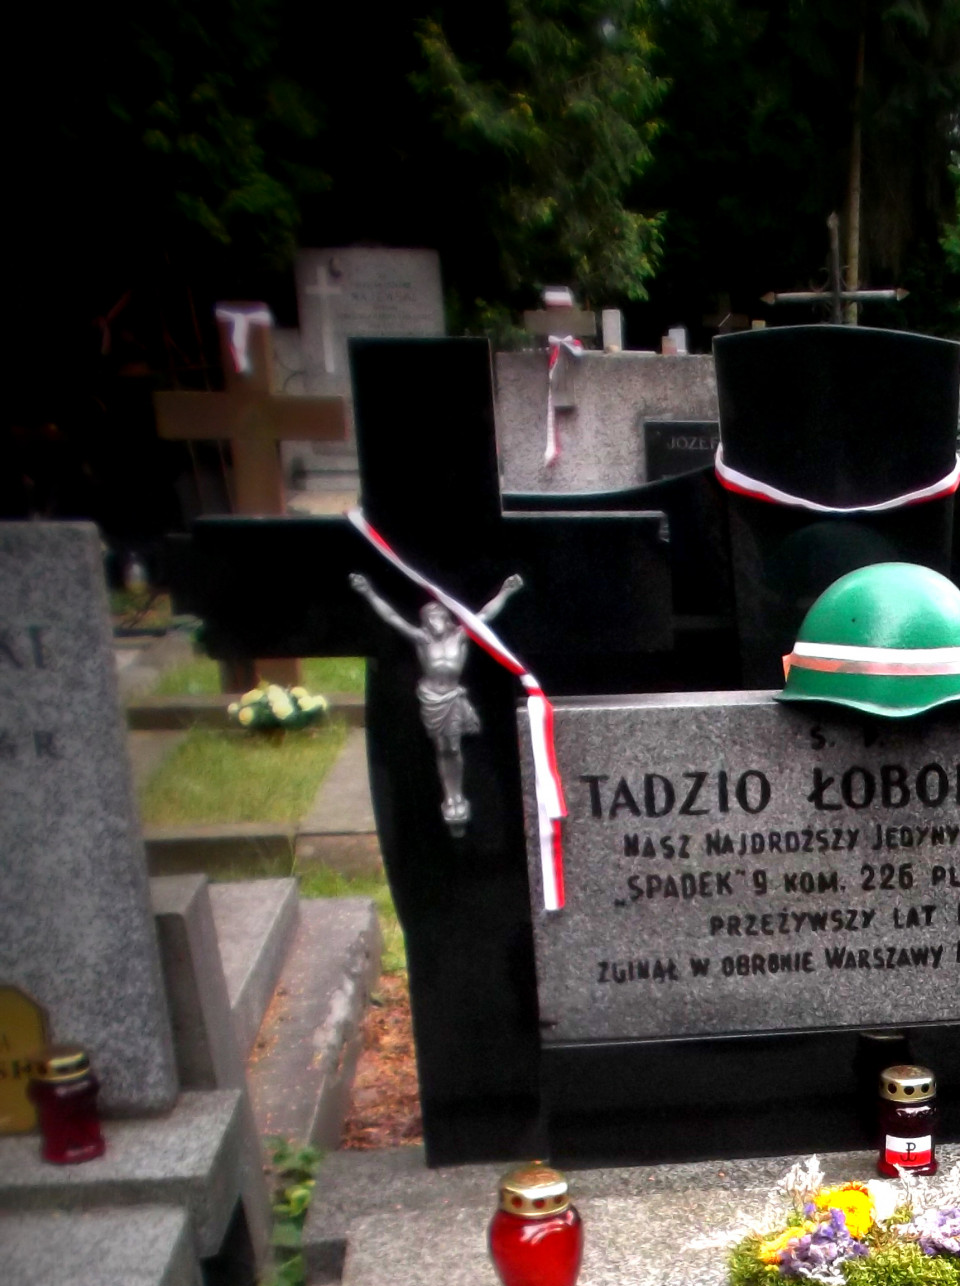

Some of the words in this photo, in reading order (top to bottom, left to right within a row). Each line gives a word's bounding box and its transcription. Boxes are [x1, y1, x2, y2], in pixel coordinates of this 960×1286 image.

[579, 768, 771, 820] TADZIO
[623, 834, 692, 859] NASZ
[752, 869, 768, 895] 9
[783, 871, 847, 895] KOM.
[860, 862, 914, 891] 226
[709, 906, 877, 937] PRZEŻYWSZY
[893, 904, 937, 929] LAT
[690, 957, 711, 978] W
[721, 951, 816, 978] OBRONIE
[824, 944, 944, 971] WARSZAWY
